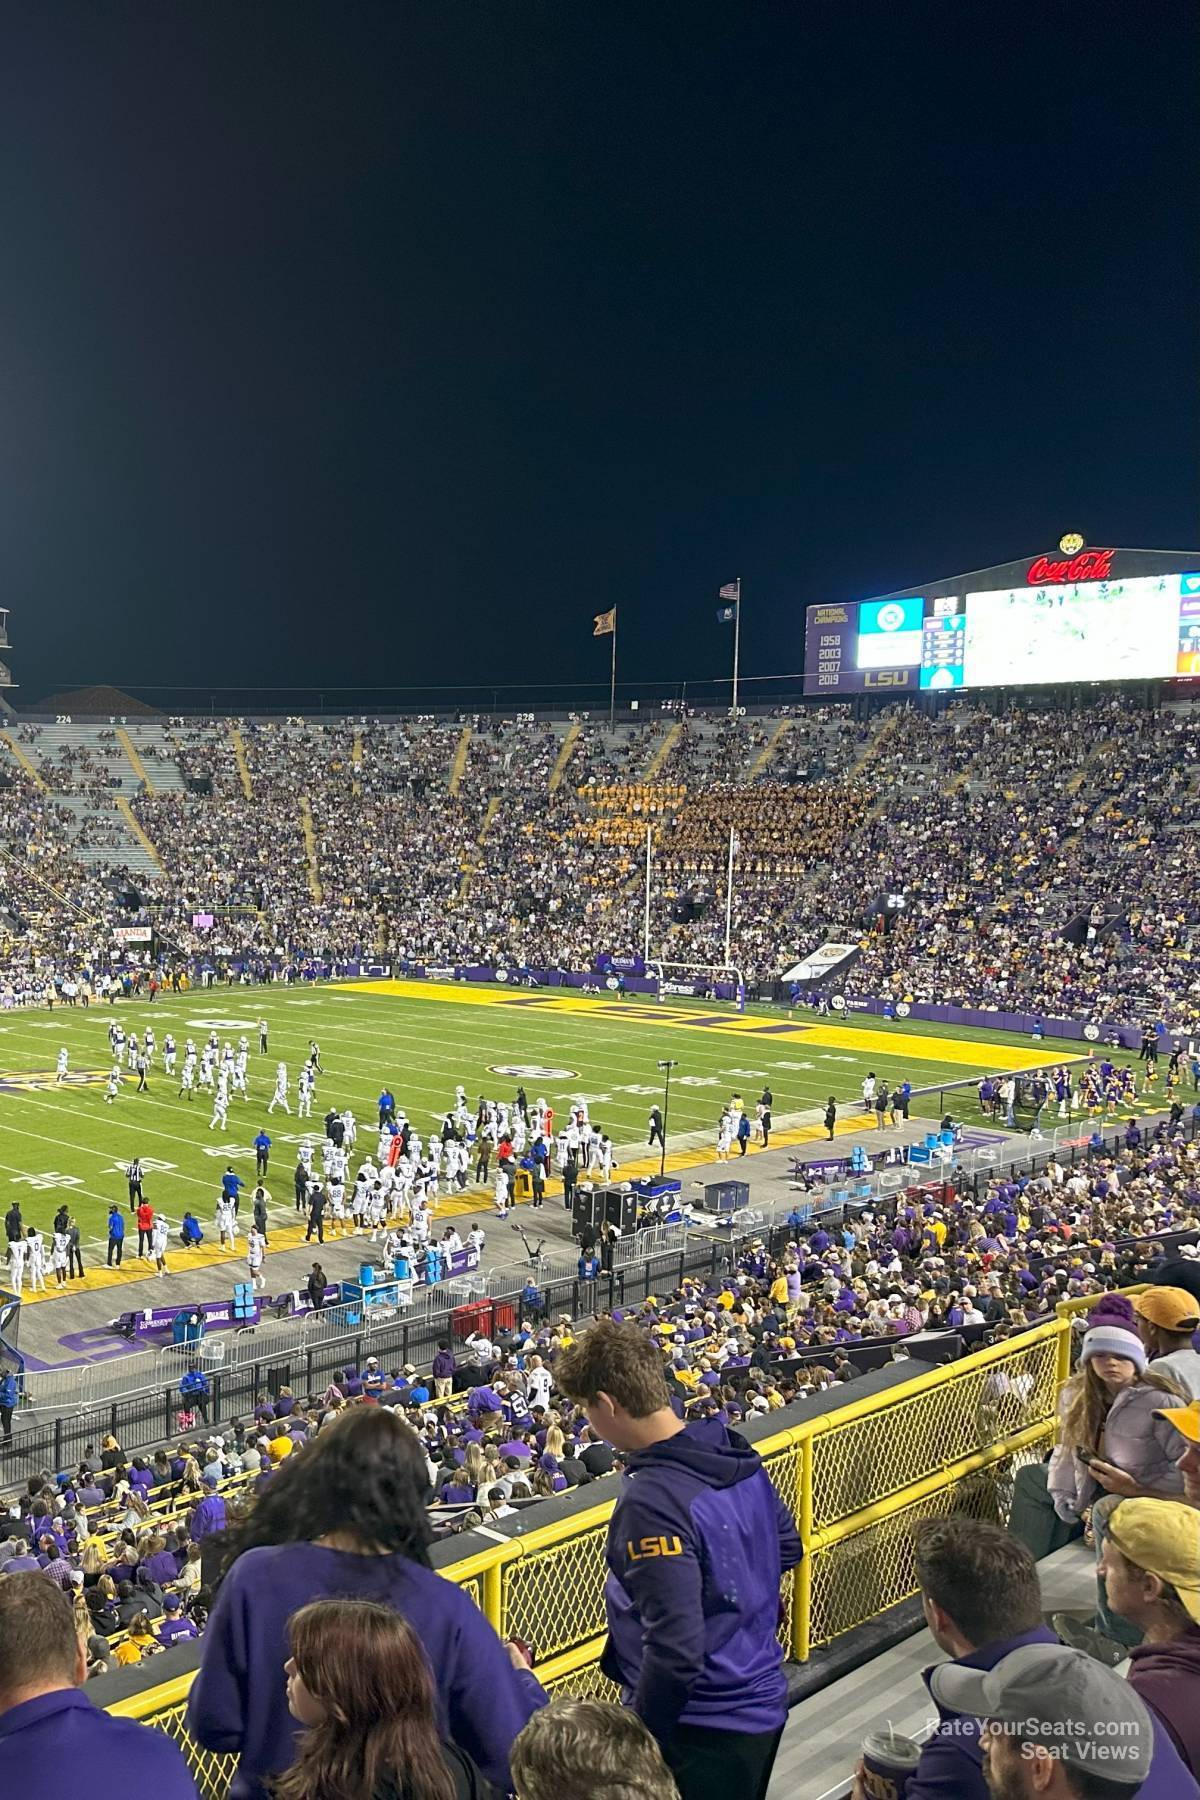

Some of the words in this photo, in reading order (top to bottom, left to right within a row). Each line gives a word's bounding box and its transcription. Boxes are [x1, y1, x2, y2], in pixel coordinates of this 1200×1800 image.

[1028, 550, 1115, 585] Coca-Cola
[816, 608, 846, 617] NATIONAL
[813, 615, 848, 625] CHAMPIONS
[820, 635, 841, 646] 1958
[818, 648, 841, 659] 2003
[818, 661, 841, 672] 2007
[818, 674, 839, 685] 2019
[864, 671, 909, 686] LSU
[55, 714, 72, 724] 224
[887, 894, 905, 908] 25
[10, 1171, 86, 1190] 35
[543, 1378, 549, 1393] 9
[626, 1535, 683, 1561] LSU
